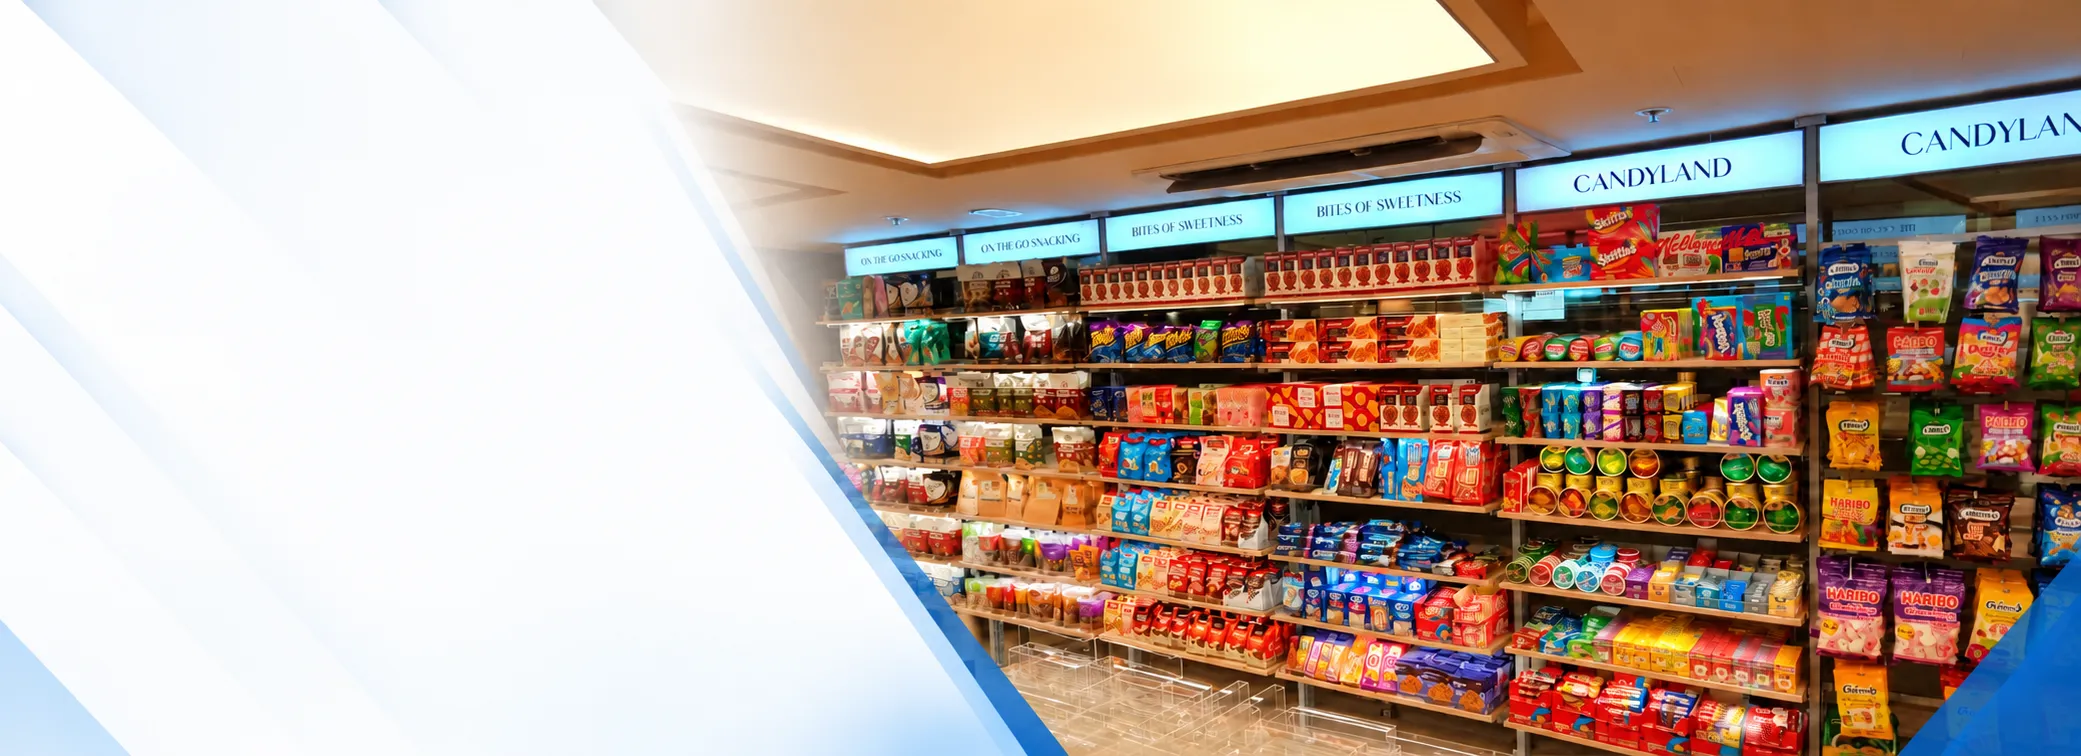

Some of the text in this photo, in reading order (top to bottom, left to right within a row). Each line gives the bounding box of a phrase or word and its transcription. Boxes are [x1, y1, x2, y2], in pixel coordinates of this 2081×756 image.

[1901, 112, 2081, 156] CANDYLAN
[1573, 157, 1732, 193] CANDYLAND
[1317, 190, 1462, 218] BITES OF SWEETNESS
[1132, 214, 1243, 237] BITES OF SWEETNESS
[981, 233, 1080, 253] ON THE GO SNACKING
[860, 248, 942, 266] ON THE GO SNACKING
[1830, 497, 1871, 510] HARIBO
[1826, 586, 1880, 605] HARIBO
[1900, 591, 1959, 610] HARIBO
